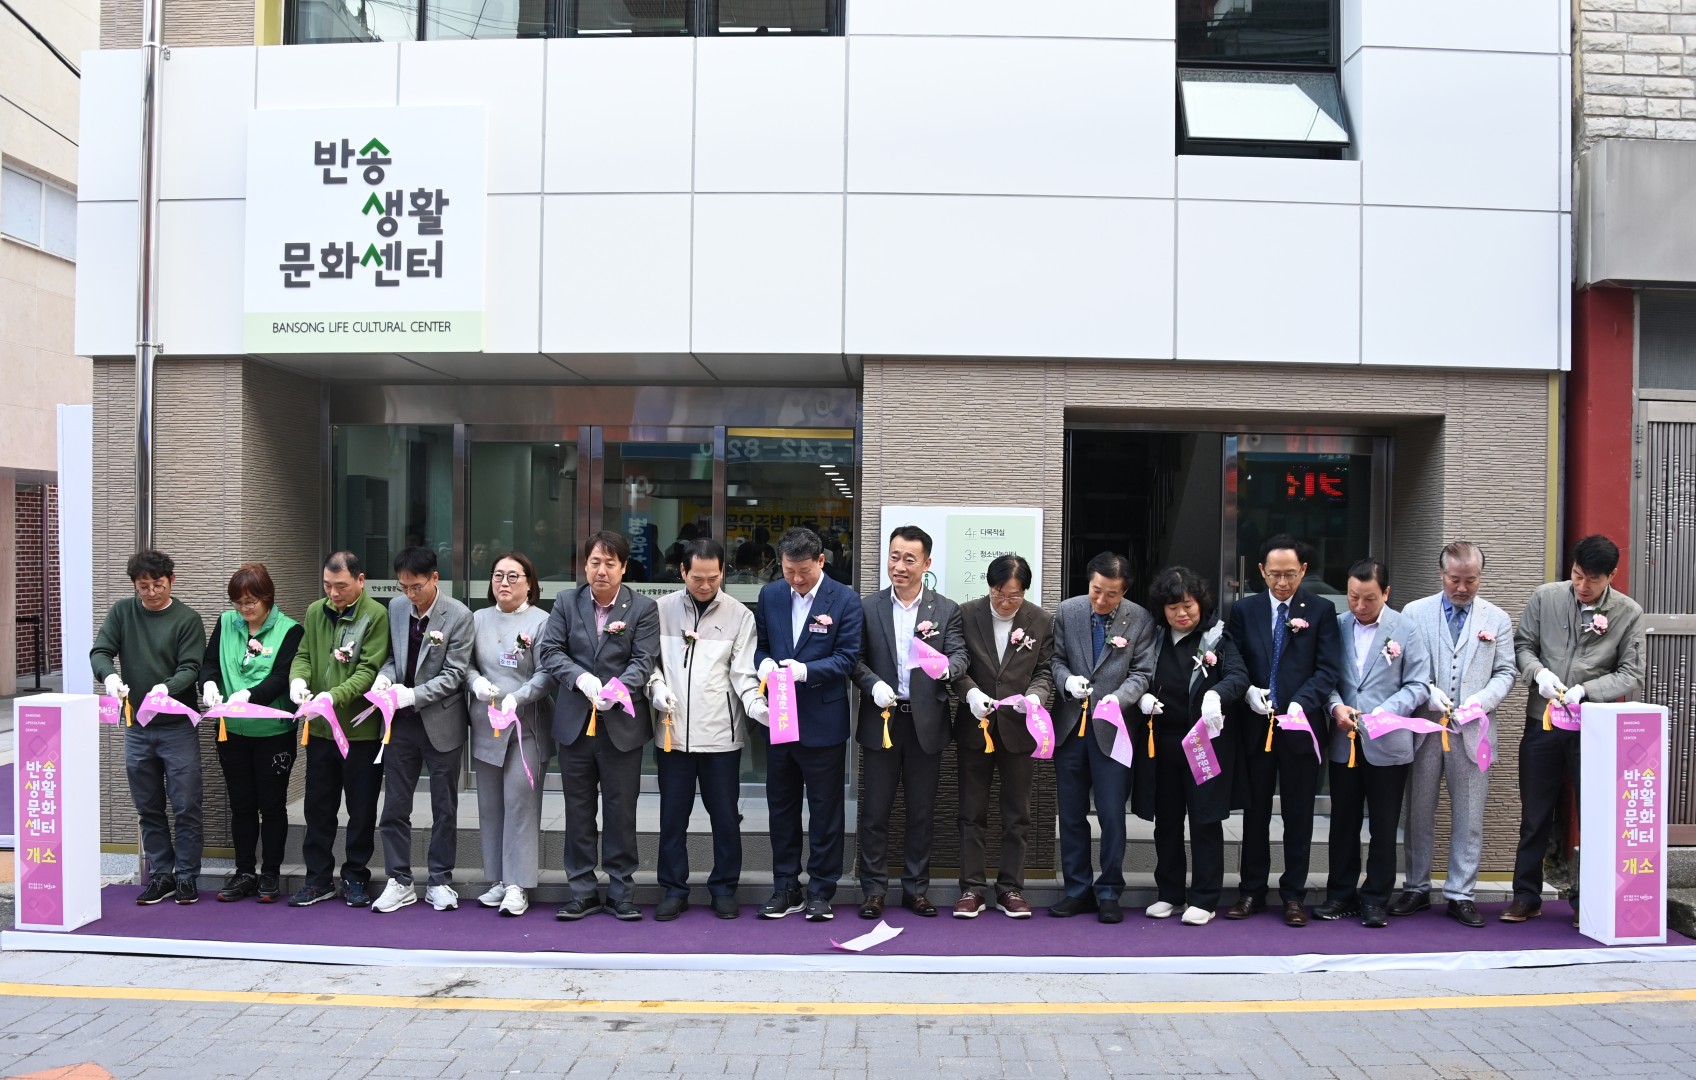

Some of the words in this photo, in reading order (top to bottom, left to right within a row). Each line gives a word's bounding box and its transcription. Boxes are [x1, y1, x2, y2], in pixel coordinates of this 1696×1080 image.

[314, 137, 392, 185] 반송
[361, 187, 449, 237] 생활
[279, 240, 443, 288] 문화센터
[272, 322, 325, 333] BANSONG
[328, 322, 349, 333] LIFE
[352, 321, 407, 333] CULTURAL
[410, 321, 451, 333] CENTER
[980, 528, 1005, 536] 다목적실
[26, 760, 56, 780] 반송
[1624, 768, 1656, 788] 반송
[25, 780, 56, 799] 생활
[1622, 788, 1656, 808] 생활
[26, 799, 56, 818] 문화
[1623, 808, 1656, 828] 문화
[25, 818, 55, 837] 센터
[1621, 827, 1654, 847] 센터
[26, 847, 57, 864] 개소
[1622, 857, 1655, 875] 개소
